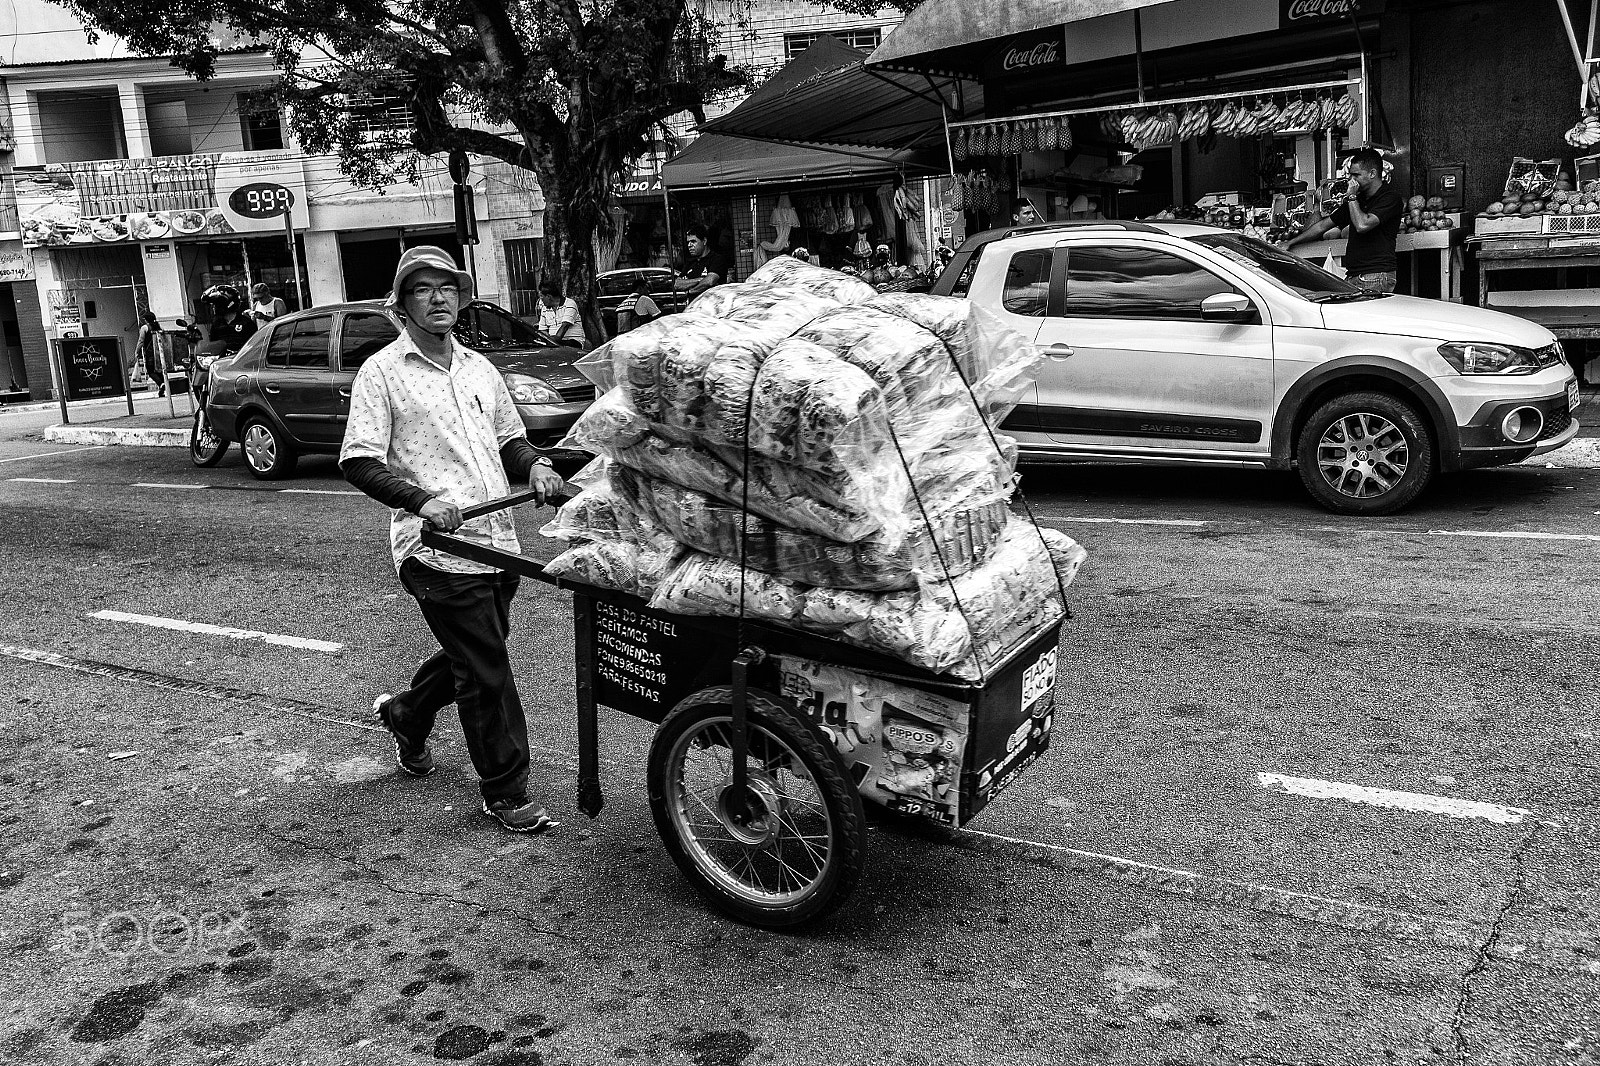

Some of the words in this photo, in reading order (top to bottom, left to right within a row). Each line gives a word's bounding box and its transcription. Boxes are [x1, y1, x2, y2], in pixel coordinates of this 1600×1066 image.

[1288, 0, 1356, 20] CocaCola
[1003, 41, 1059, 71] Coca-Cola
[152, 173, 208, 184] Restaurante
[1140, 424, 1190, 434] SAVEIRO
[1195, 427, 1238, 436] CROSS
[596, 601, 620, 619] CASA
[622, 608, 637, 623] DO
[640, 614, 678, 637] PASTEL
[596, 615, 648, 643] ACEITAMOS
[597, 631, 662, 666] ENCOMENDAS
[1023, 650, 1056, 688] FIADO
